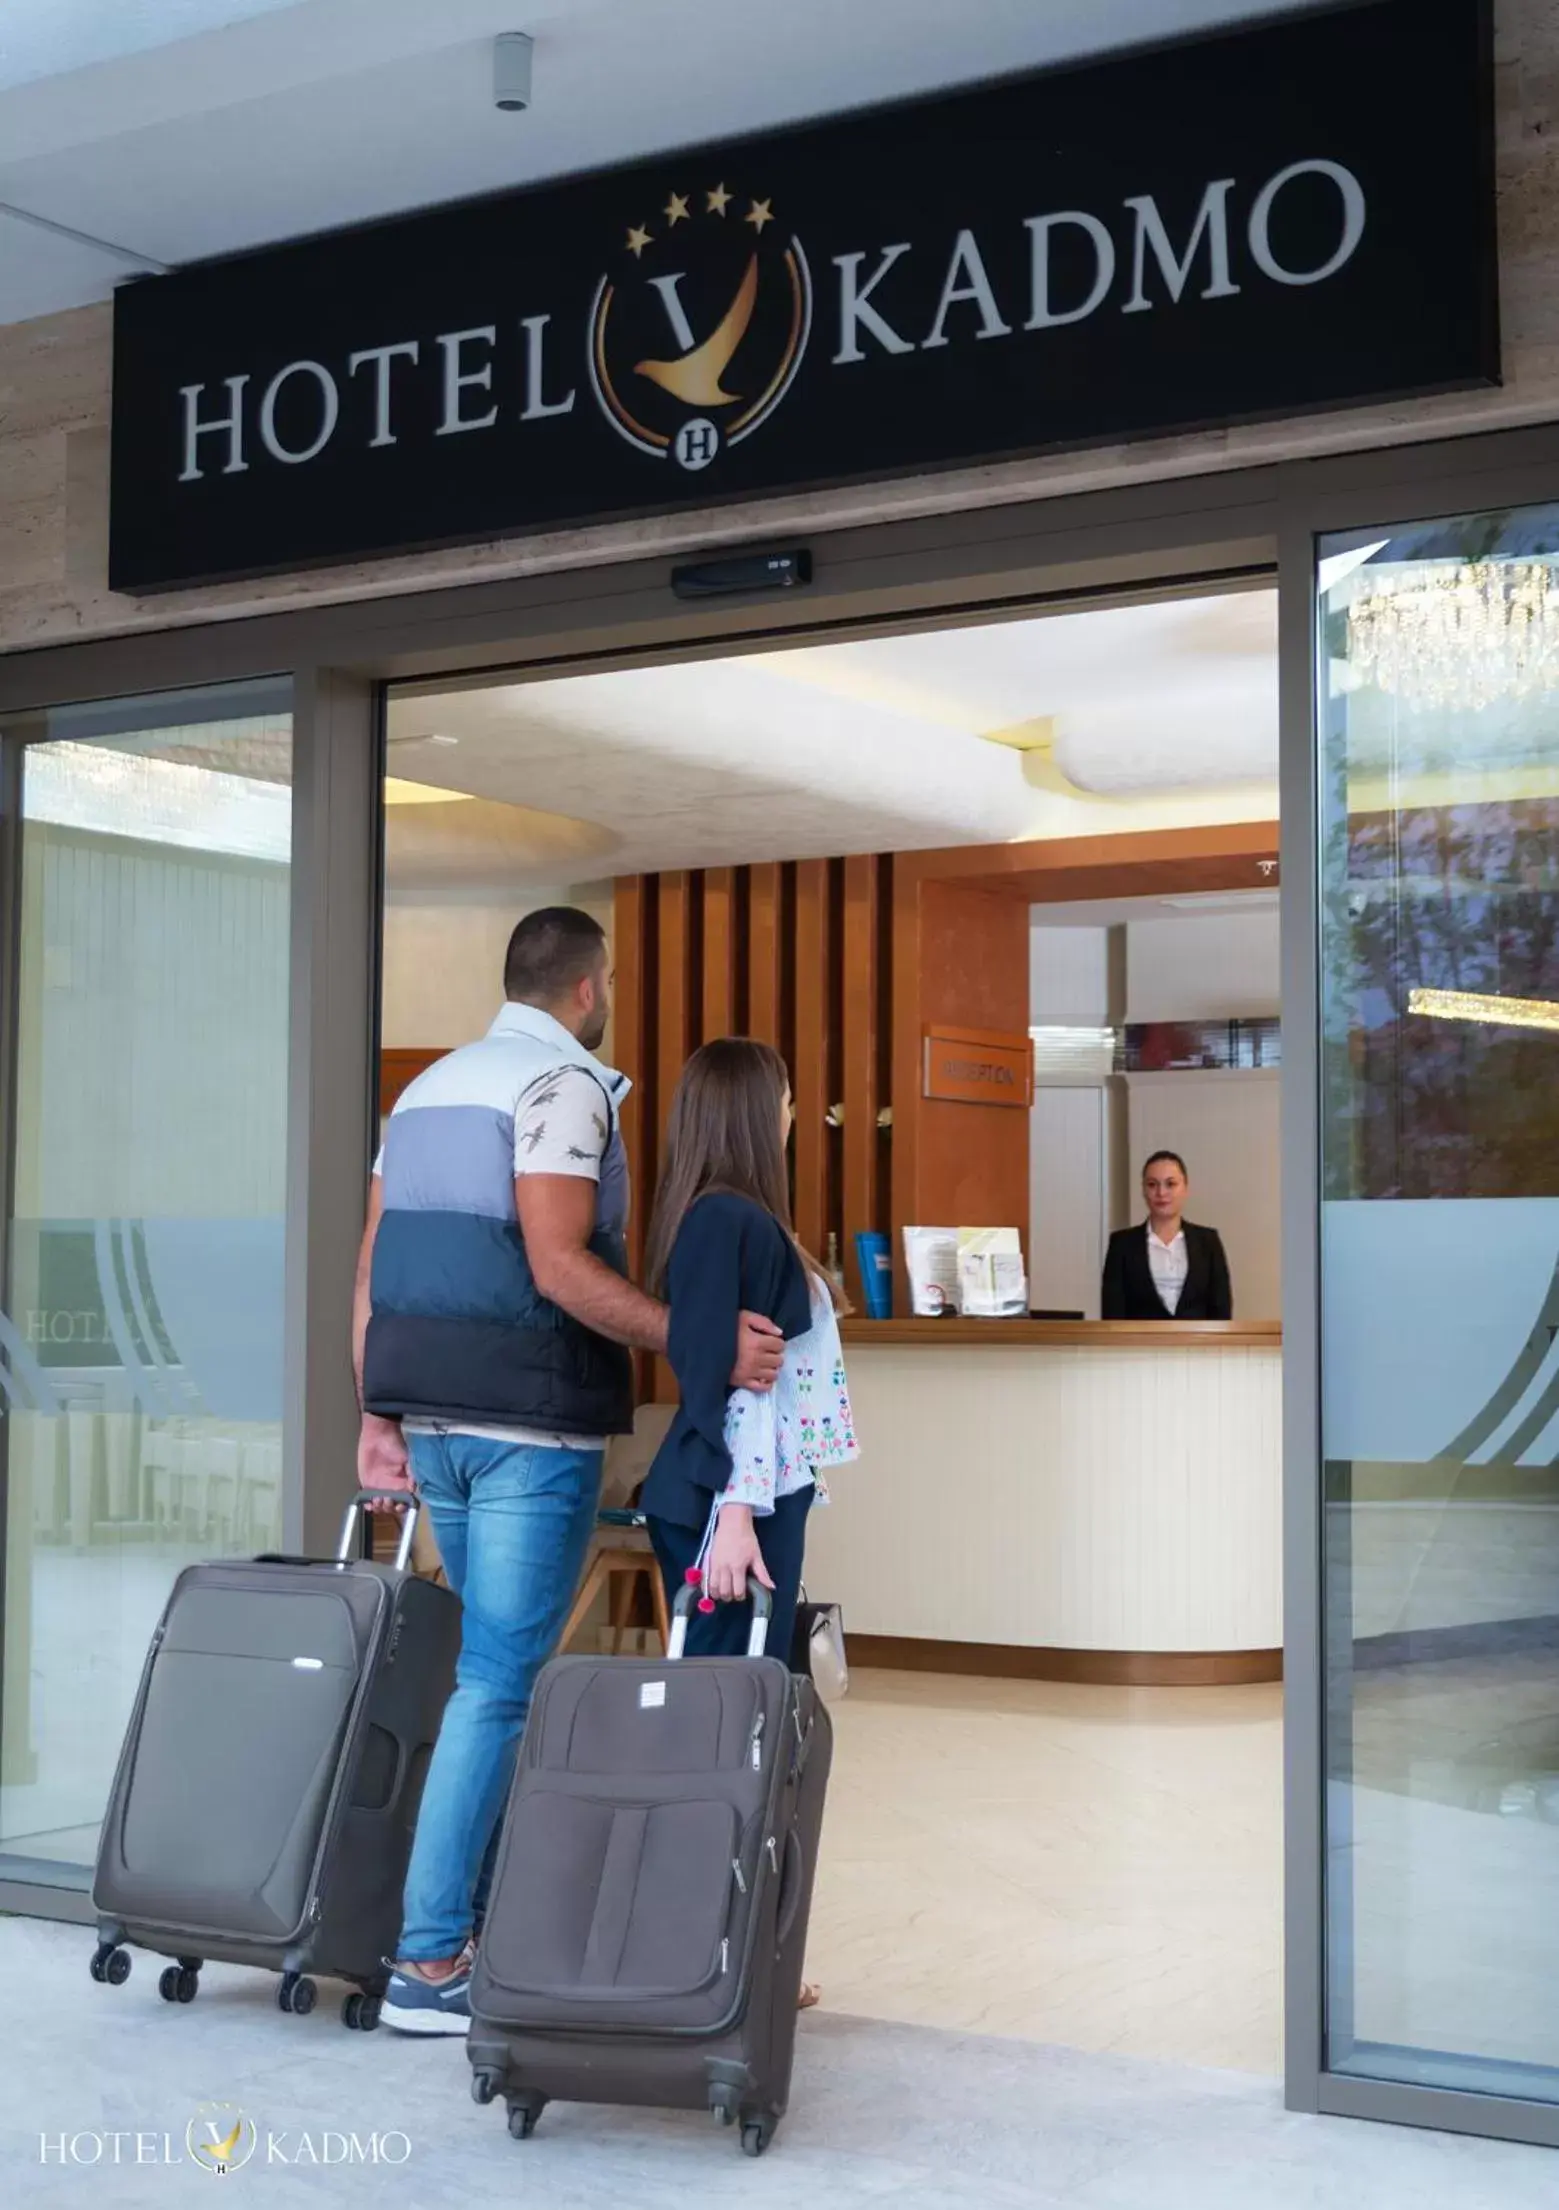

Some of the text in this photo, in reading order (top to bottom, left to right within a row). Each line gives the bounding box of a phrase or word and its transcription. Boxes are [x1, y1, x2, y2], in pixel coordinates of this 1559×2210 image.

[177, 314, 577, 482] HOTEL
[831, 158, 1367, 365] KADMO
[683, 427, 712, 462] H
